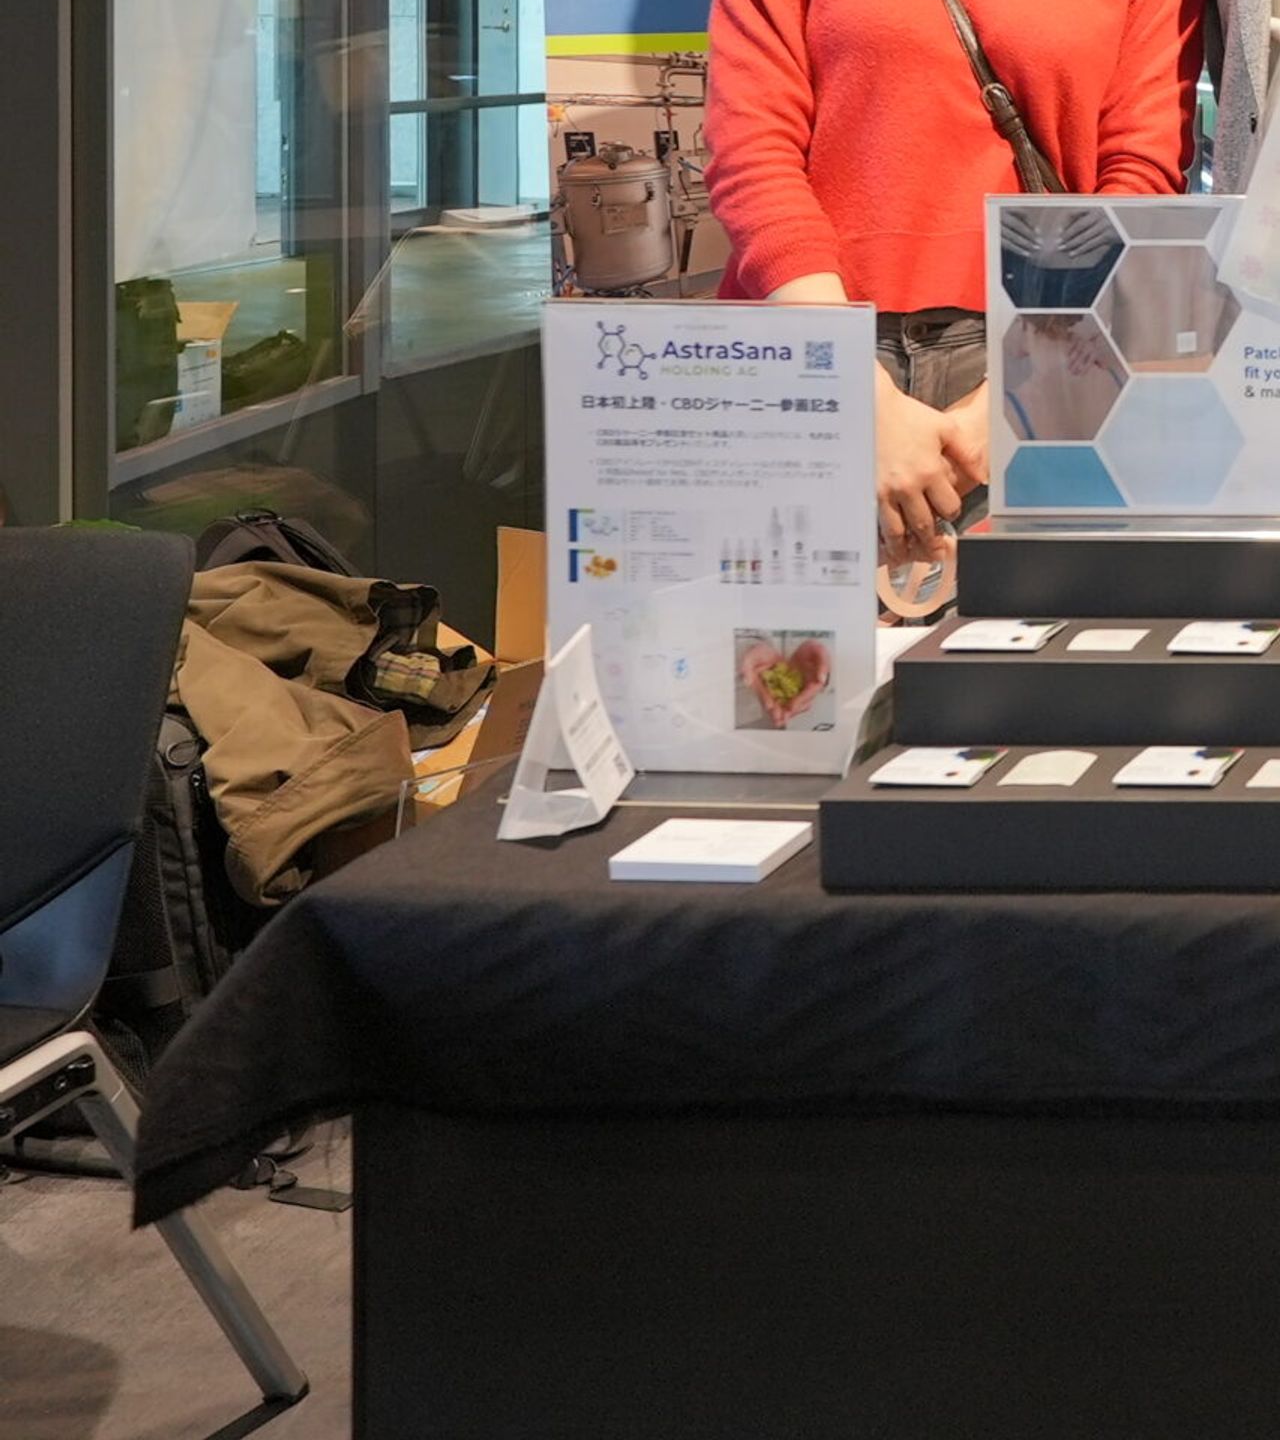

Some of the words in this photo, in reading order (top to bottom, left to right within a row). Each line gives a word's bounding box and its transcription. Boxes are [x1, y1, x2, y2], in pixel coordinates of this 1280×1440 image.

[661, 341, 793, 361] AstraSana
[660, 365, 732, 376] HOLDING
[1244, 366, 1259, 379] fit
[1243, 385, 1255, 398] &
